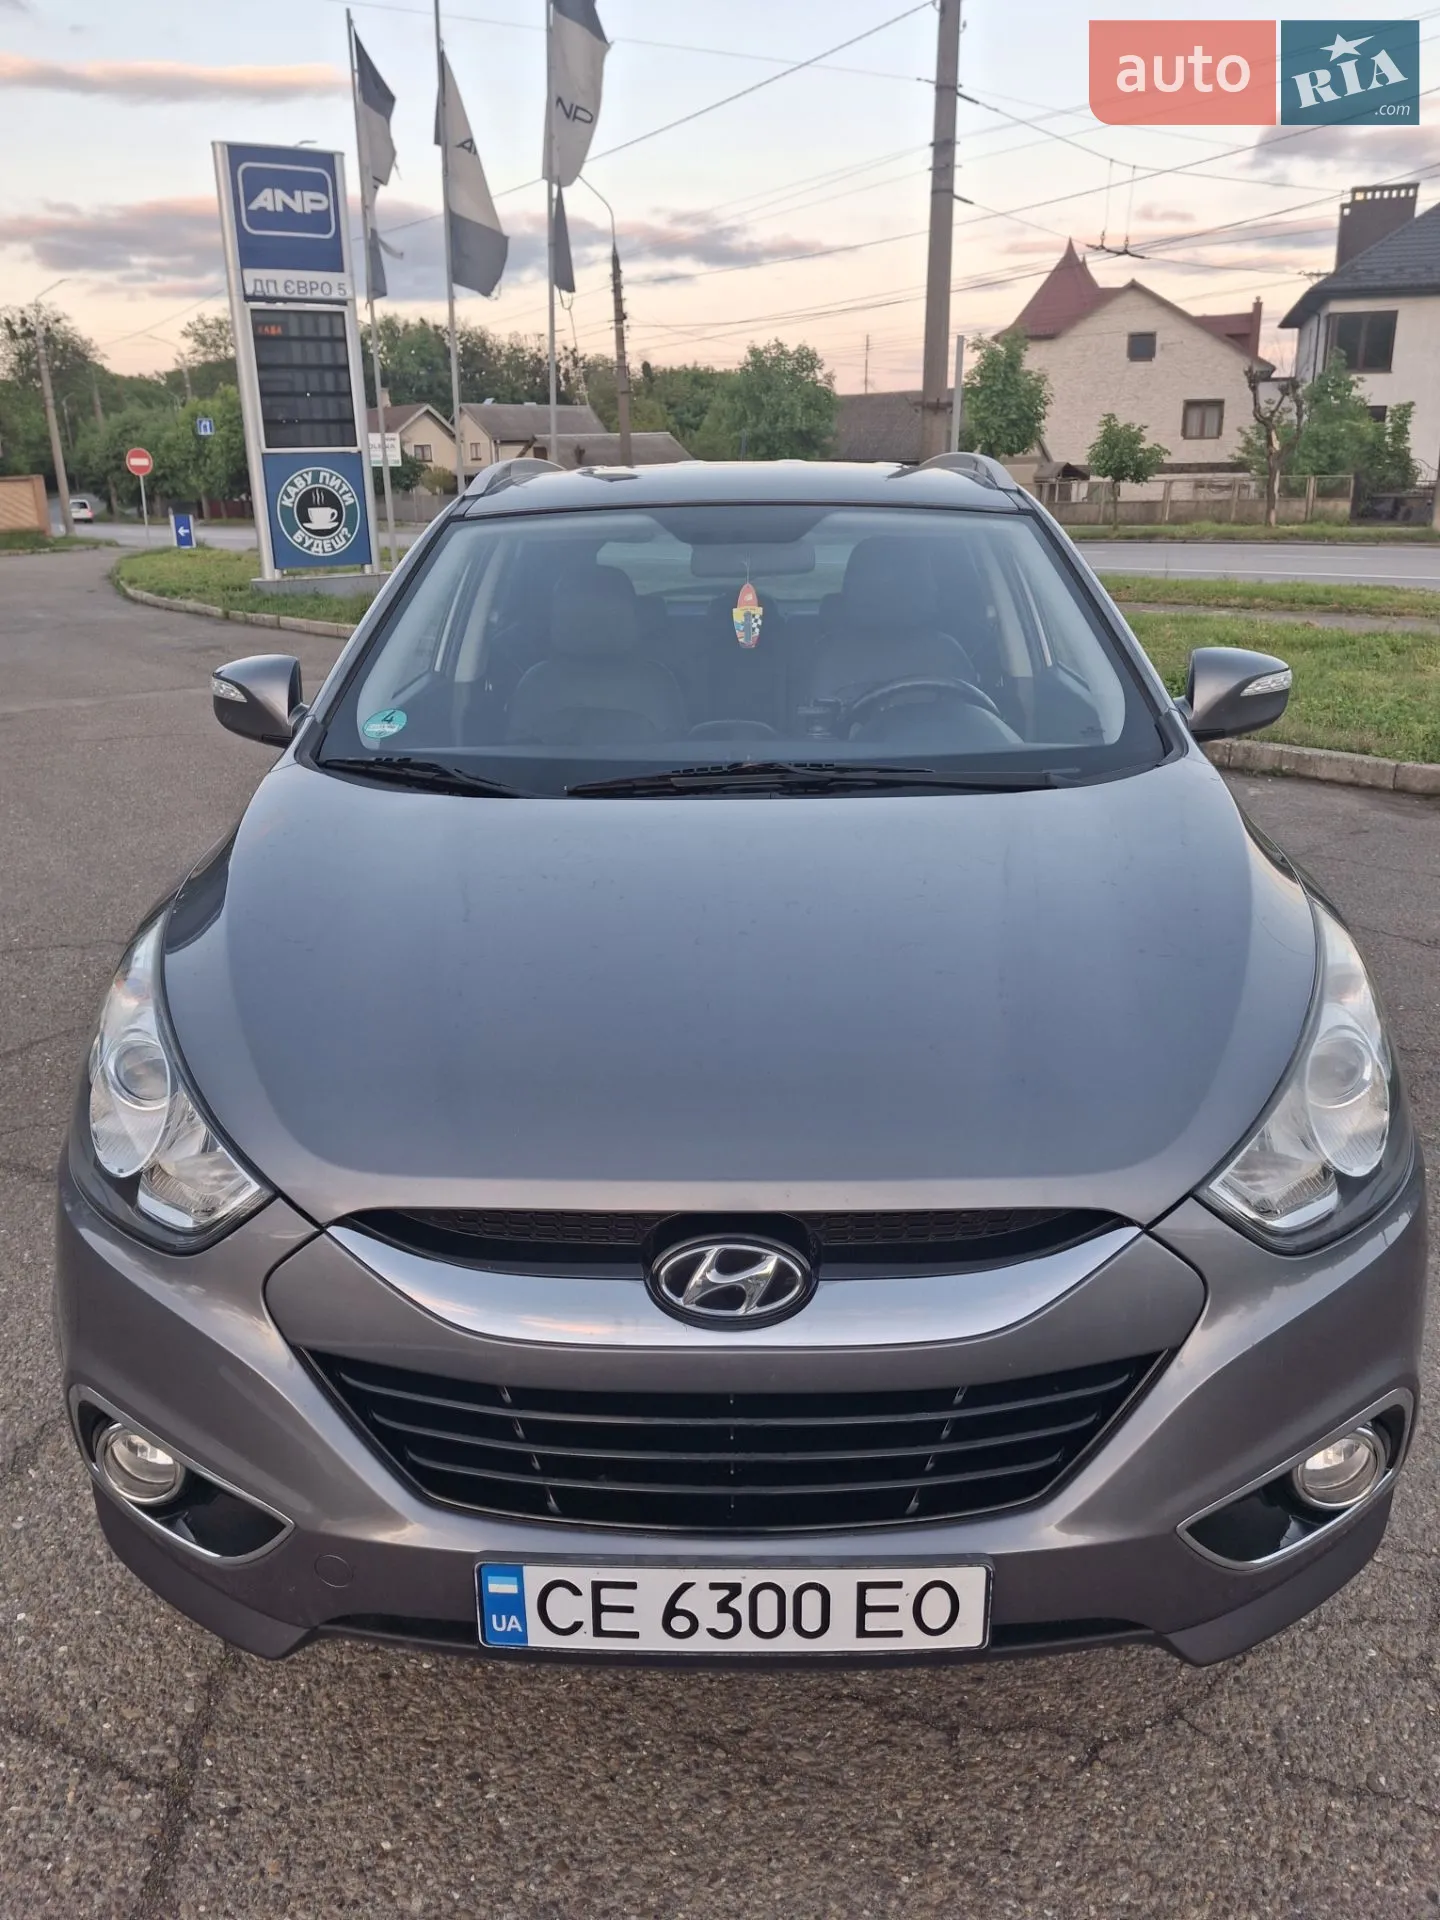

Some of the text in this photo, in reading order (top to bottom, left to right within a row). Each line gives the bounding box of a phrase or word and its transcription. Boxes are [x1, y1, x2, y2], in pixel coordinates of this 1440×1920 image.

[248, 187, 330, 214] ANP
[253, 278, 347, 297] ДП ЄВРО 5
[281, 471, 355, 507] КАВУ ПИТИ
[292, 527, 351, 554] БУДЕШ?
[381, 710, 397, 724] 4
[536, 1578, 960, 1640] CE 6300 EO
[492, 1614, 523, 1633] UA
